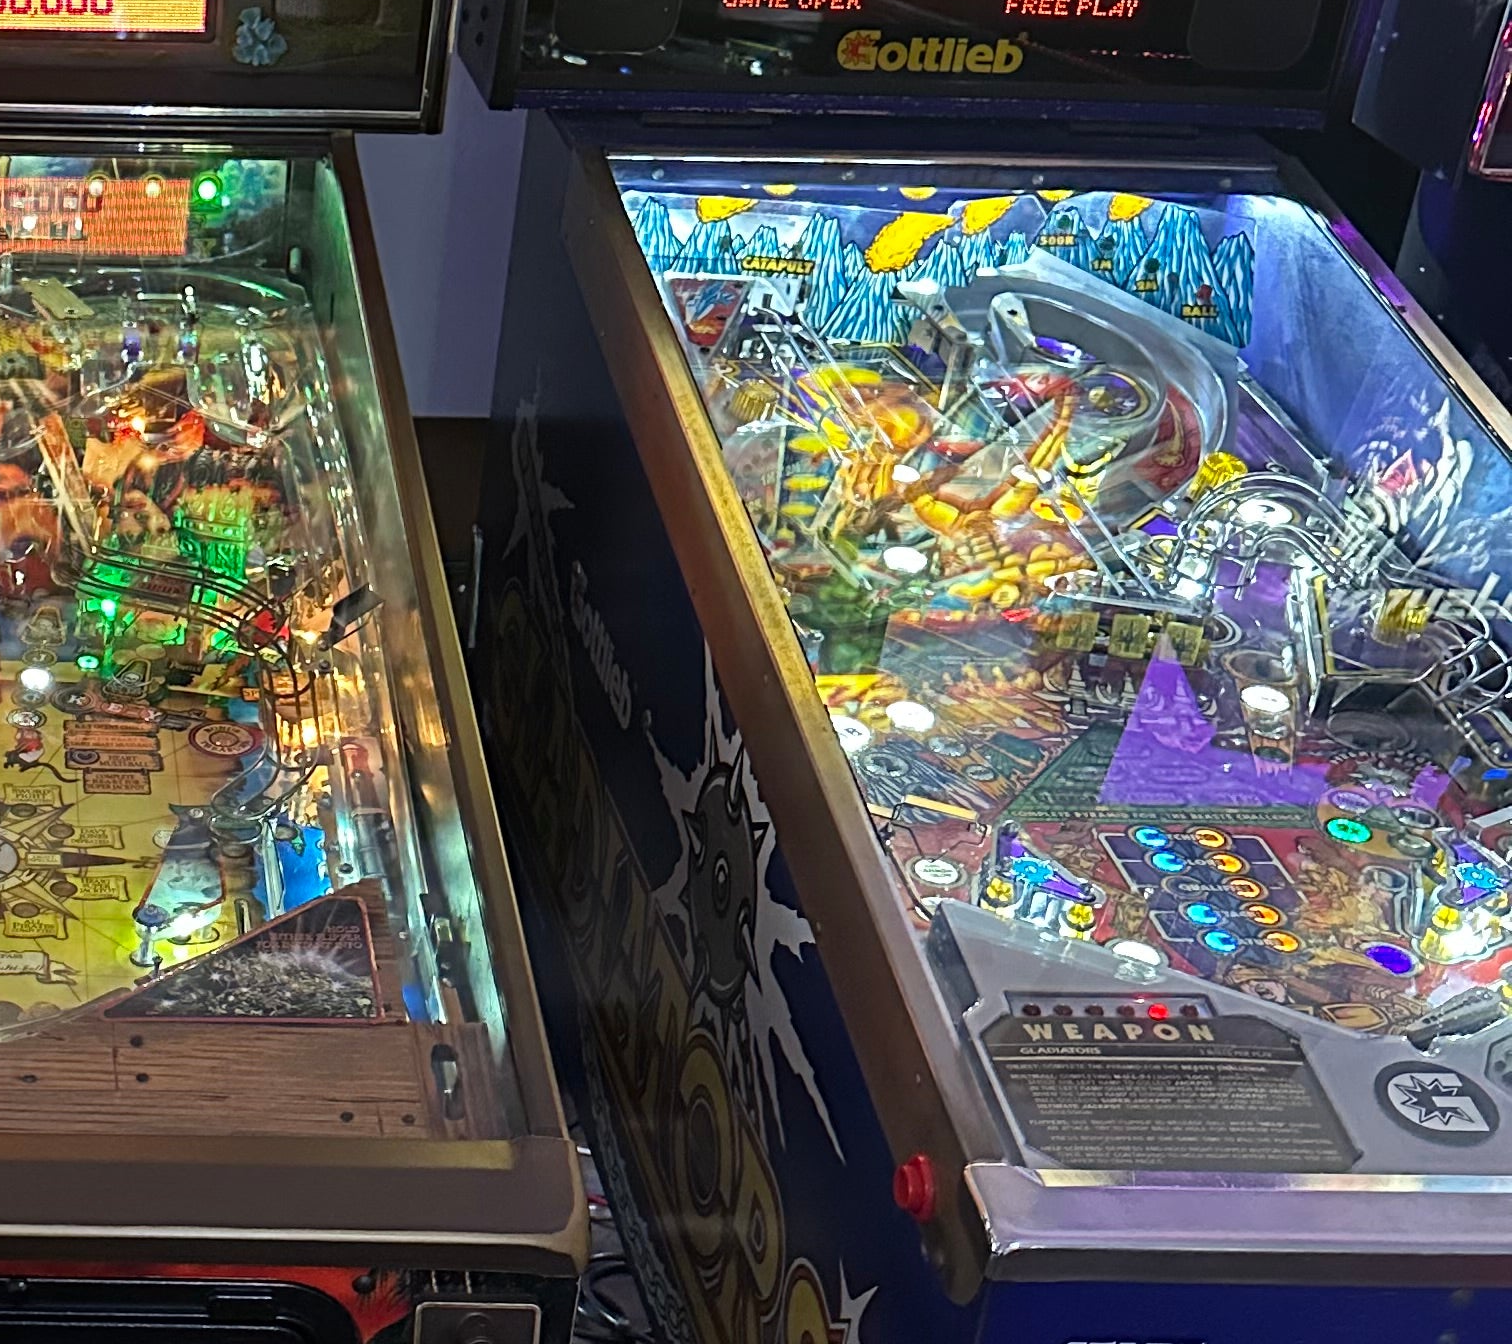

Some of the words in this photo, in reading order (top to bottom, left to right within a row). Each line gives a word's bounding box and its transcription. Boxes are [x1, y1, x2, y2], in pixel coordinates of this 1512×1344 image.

[838, 29, 1024, 75] Gottlieb
[741, 256, 815, 276] CATAPULT
[1181, 305, 1218, 319] BALL
[1023, 1022, 1215, 1042] WEAPON
[1020, 1046, 1102, 1055] GLADIATORS
